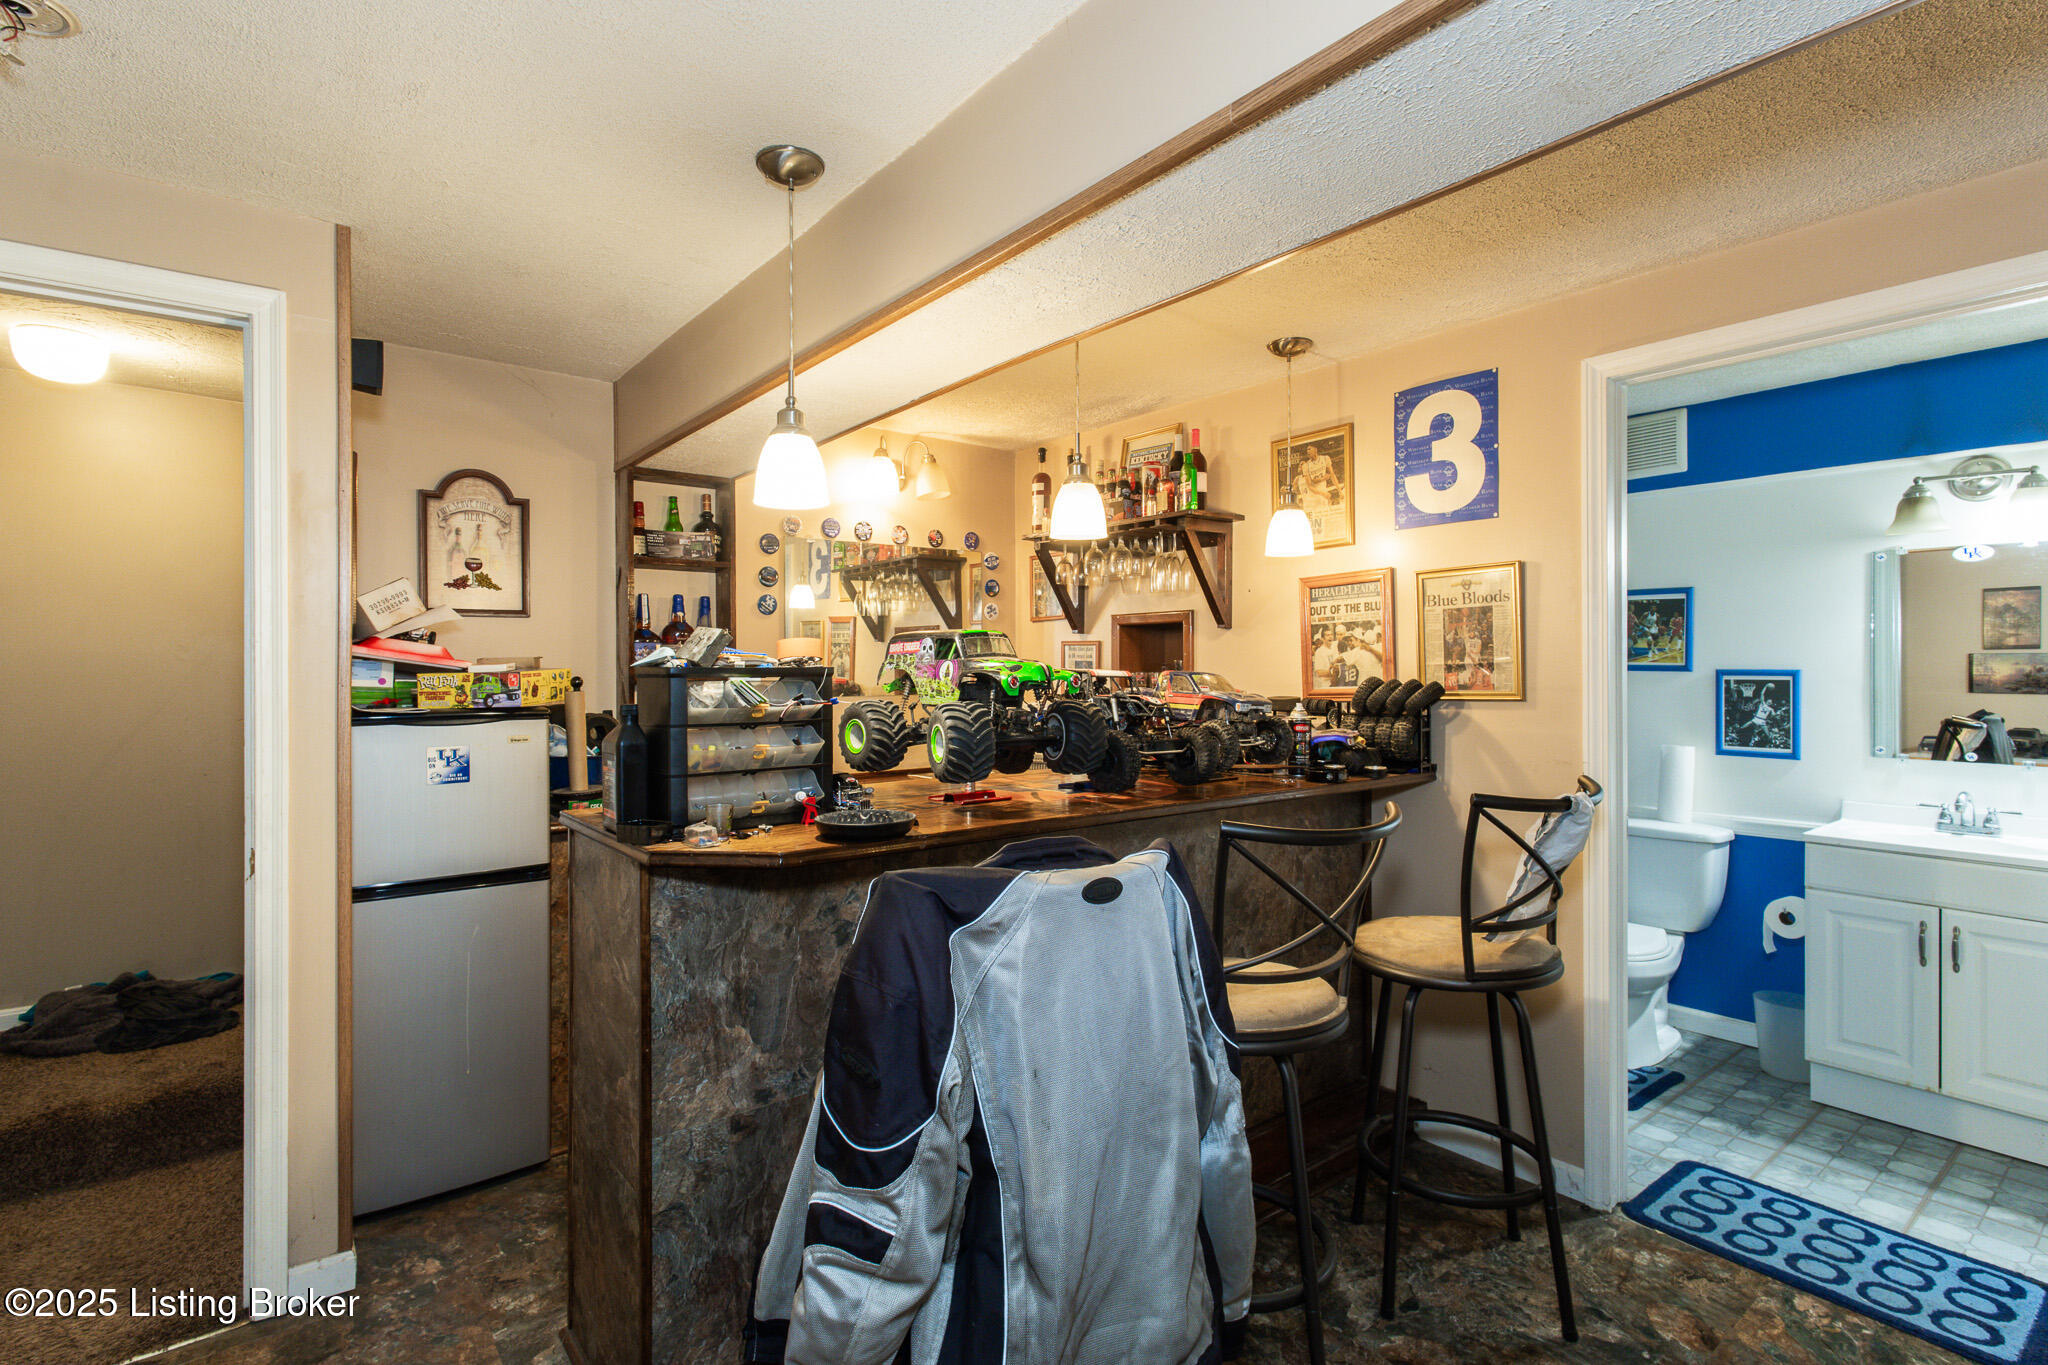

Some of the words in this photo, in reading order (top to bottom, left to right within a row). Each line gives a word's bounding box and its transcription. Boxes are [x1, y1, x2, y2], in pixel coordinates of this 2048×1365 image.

[1130, 450, 1169, 465] KENTUCKY
[1405, 389, 1486, 514] 3
[453, 499, 474, 511] SERVE
[1426, 593, 1458, 607] Blue
[1461, 589, 1511, 605] Bloods
[1311, 606, 1328, 617] OUT
[1330, 604, 1342, 615] OF
[1344, 602, 1362, 614] THE
[1345, 665, 1358, 682] 12
[435, 749, 468, 768] UK
